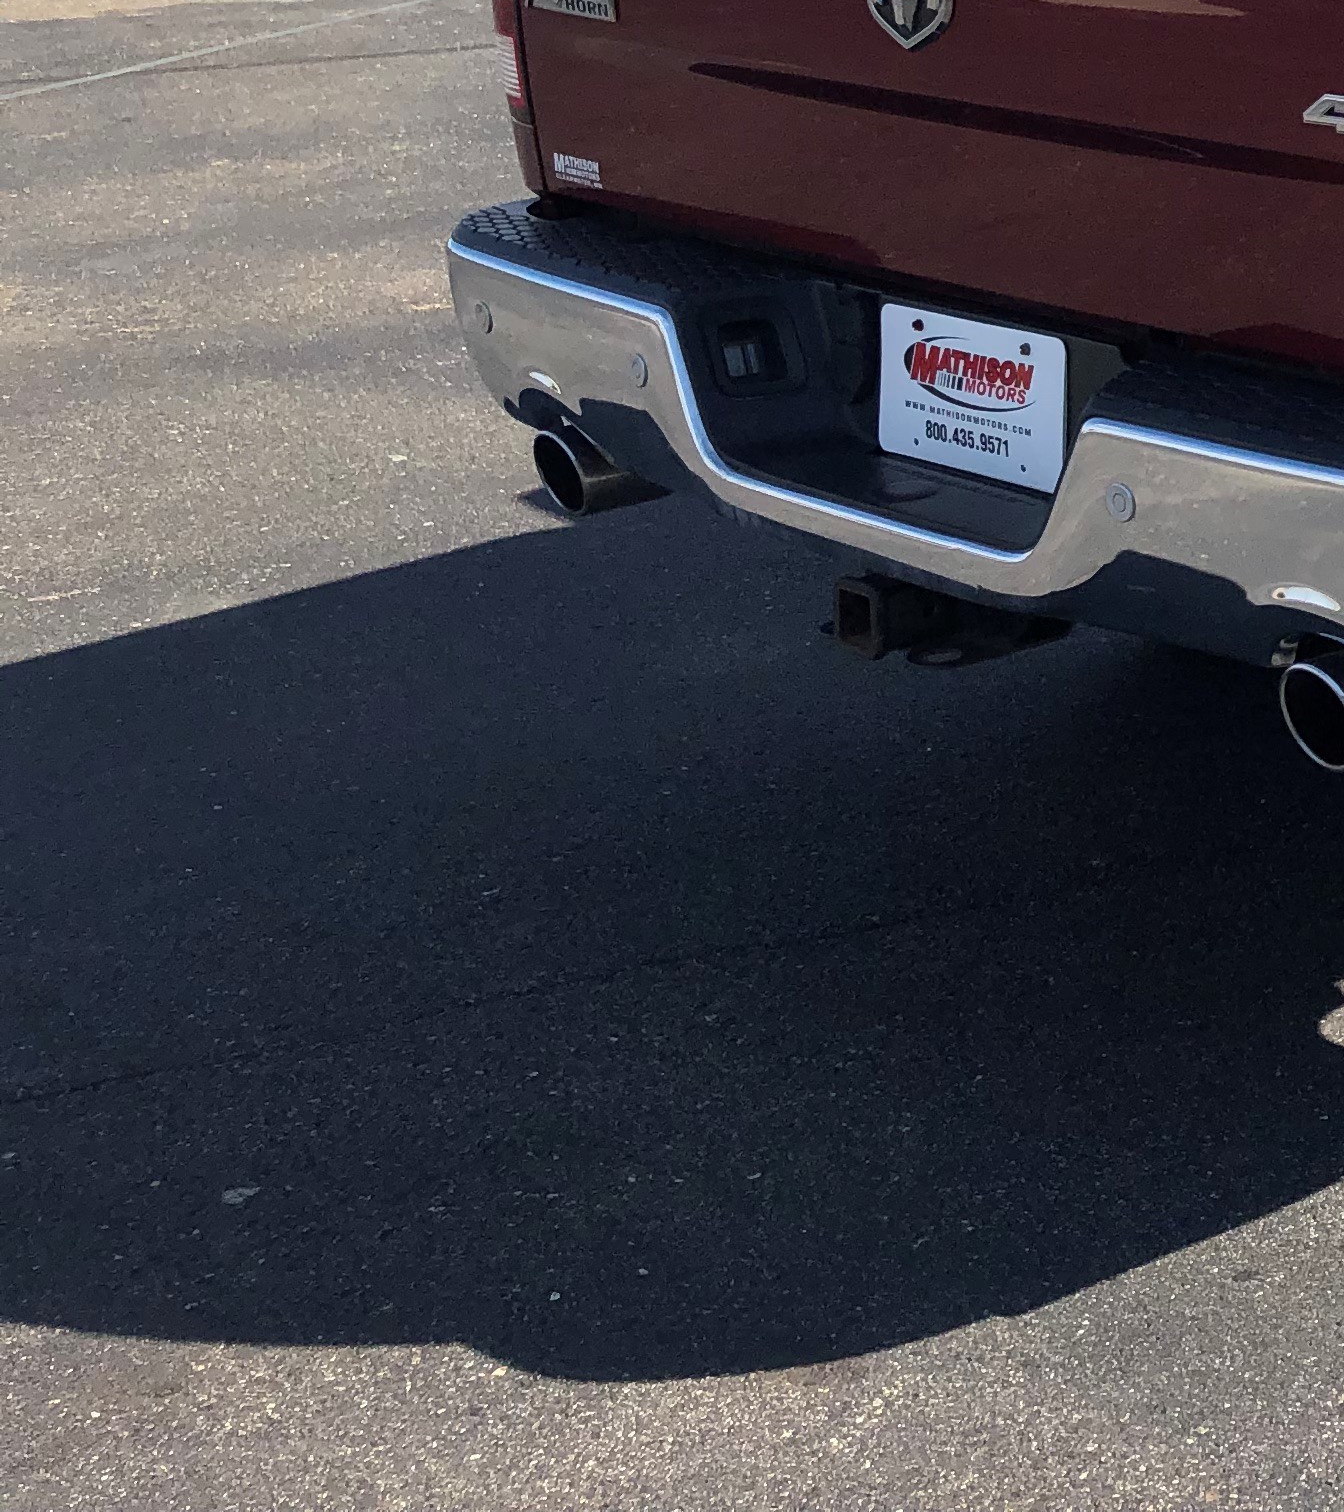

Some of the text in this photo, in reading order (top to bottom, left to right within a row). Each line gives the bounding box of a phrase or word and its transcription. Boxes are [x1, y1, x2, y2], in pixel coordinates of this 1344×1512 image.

[910, 341, 1035, 391] MATHISON
[963, 377, 1028, 405] MOTORS
[904, 399, 1033, 437] WWW.MATHISONMOTORS.COM
[925, 419, 1011, 458] 800.435.9571
